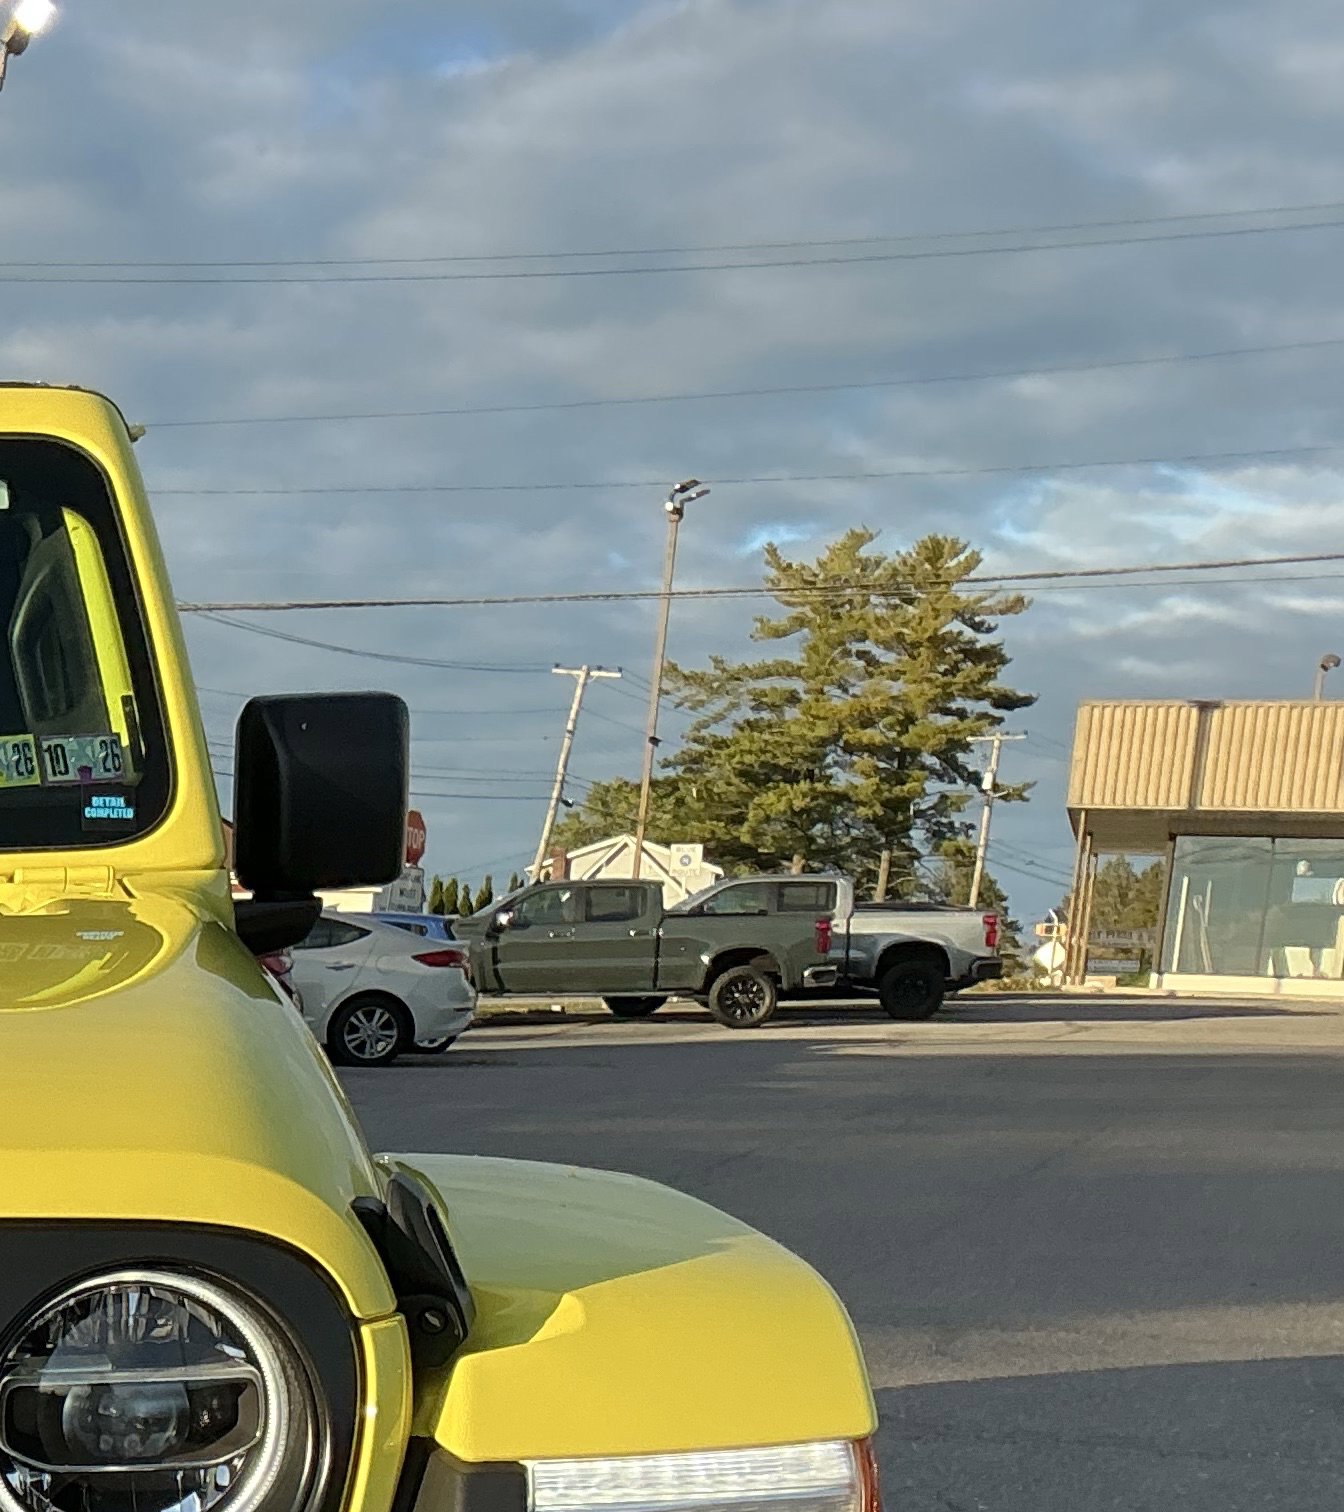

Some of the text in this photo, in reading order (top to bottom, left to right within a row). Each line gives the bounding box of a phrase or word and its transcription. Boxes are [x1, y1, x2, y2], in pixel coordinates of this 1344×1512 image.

[12, 742, 35, 777] 26
[44, 738, 122, 778] 10 26
[84, 807, 134, 819] COMPLETED
[91, 796, 126, 807] DETAIL
[407, 826, 425, 849] TOP
